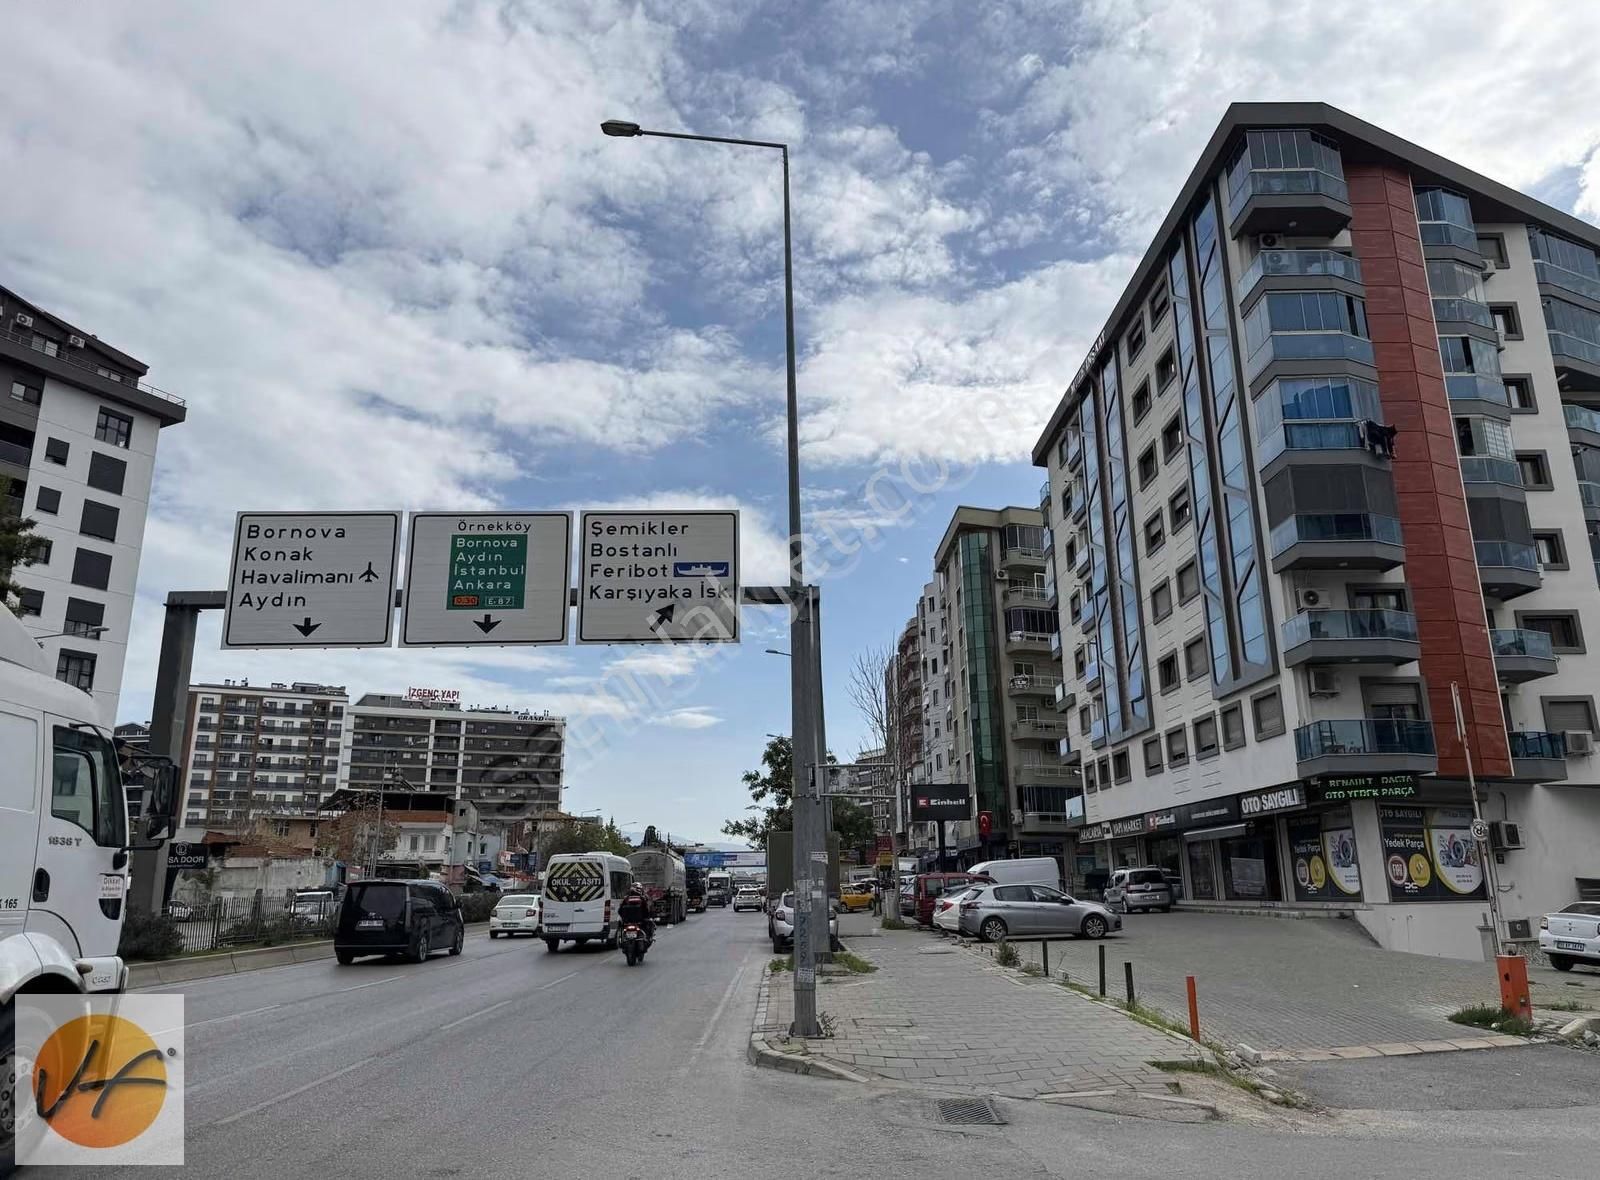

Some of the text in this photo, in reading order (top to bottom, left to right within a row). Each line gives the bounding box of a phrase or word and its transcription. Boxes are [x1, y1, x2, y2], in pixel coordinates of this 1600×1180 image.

[247, 524, 346, 539] Bornova
[458, 519, 531, 533] Örnekköy
[591, 521, 689, 537] Şemikler
[456, 537, 518, 548] Bornova
[590, 542, 677, 557] Bostanlı
[244, 546, 313, 561] Konak
[456, 551, 503, 564] Aydın
[241, 569, 353, 584] Havalimanı
[454, 563, 524, 576] İstanbul
[590, 563, 668, 578] Feribot
[453, 579, 512, 590] Ankara
[589, 584, 692, 604] Karşıyaka
[239, 592, 306, 611] Aydın
[441, 690, 460, 700] YAPI
[930, 798, 966, 806] Einhell
[1241, 796, 1260, 814] OTO
[1261, 788, 1298, 810] SAYGILI
[1384, 838, 1424, 850] Yedek Parça
[551, 878, 571, 886] OKUL
[4, 898, 18, 909] 165
